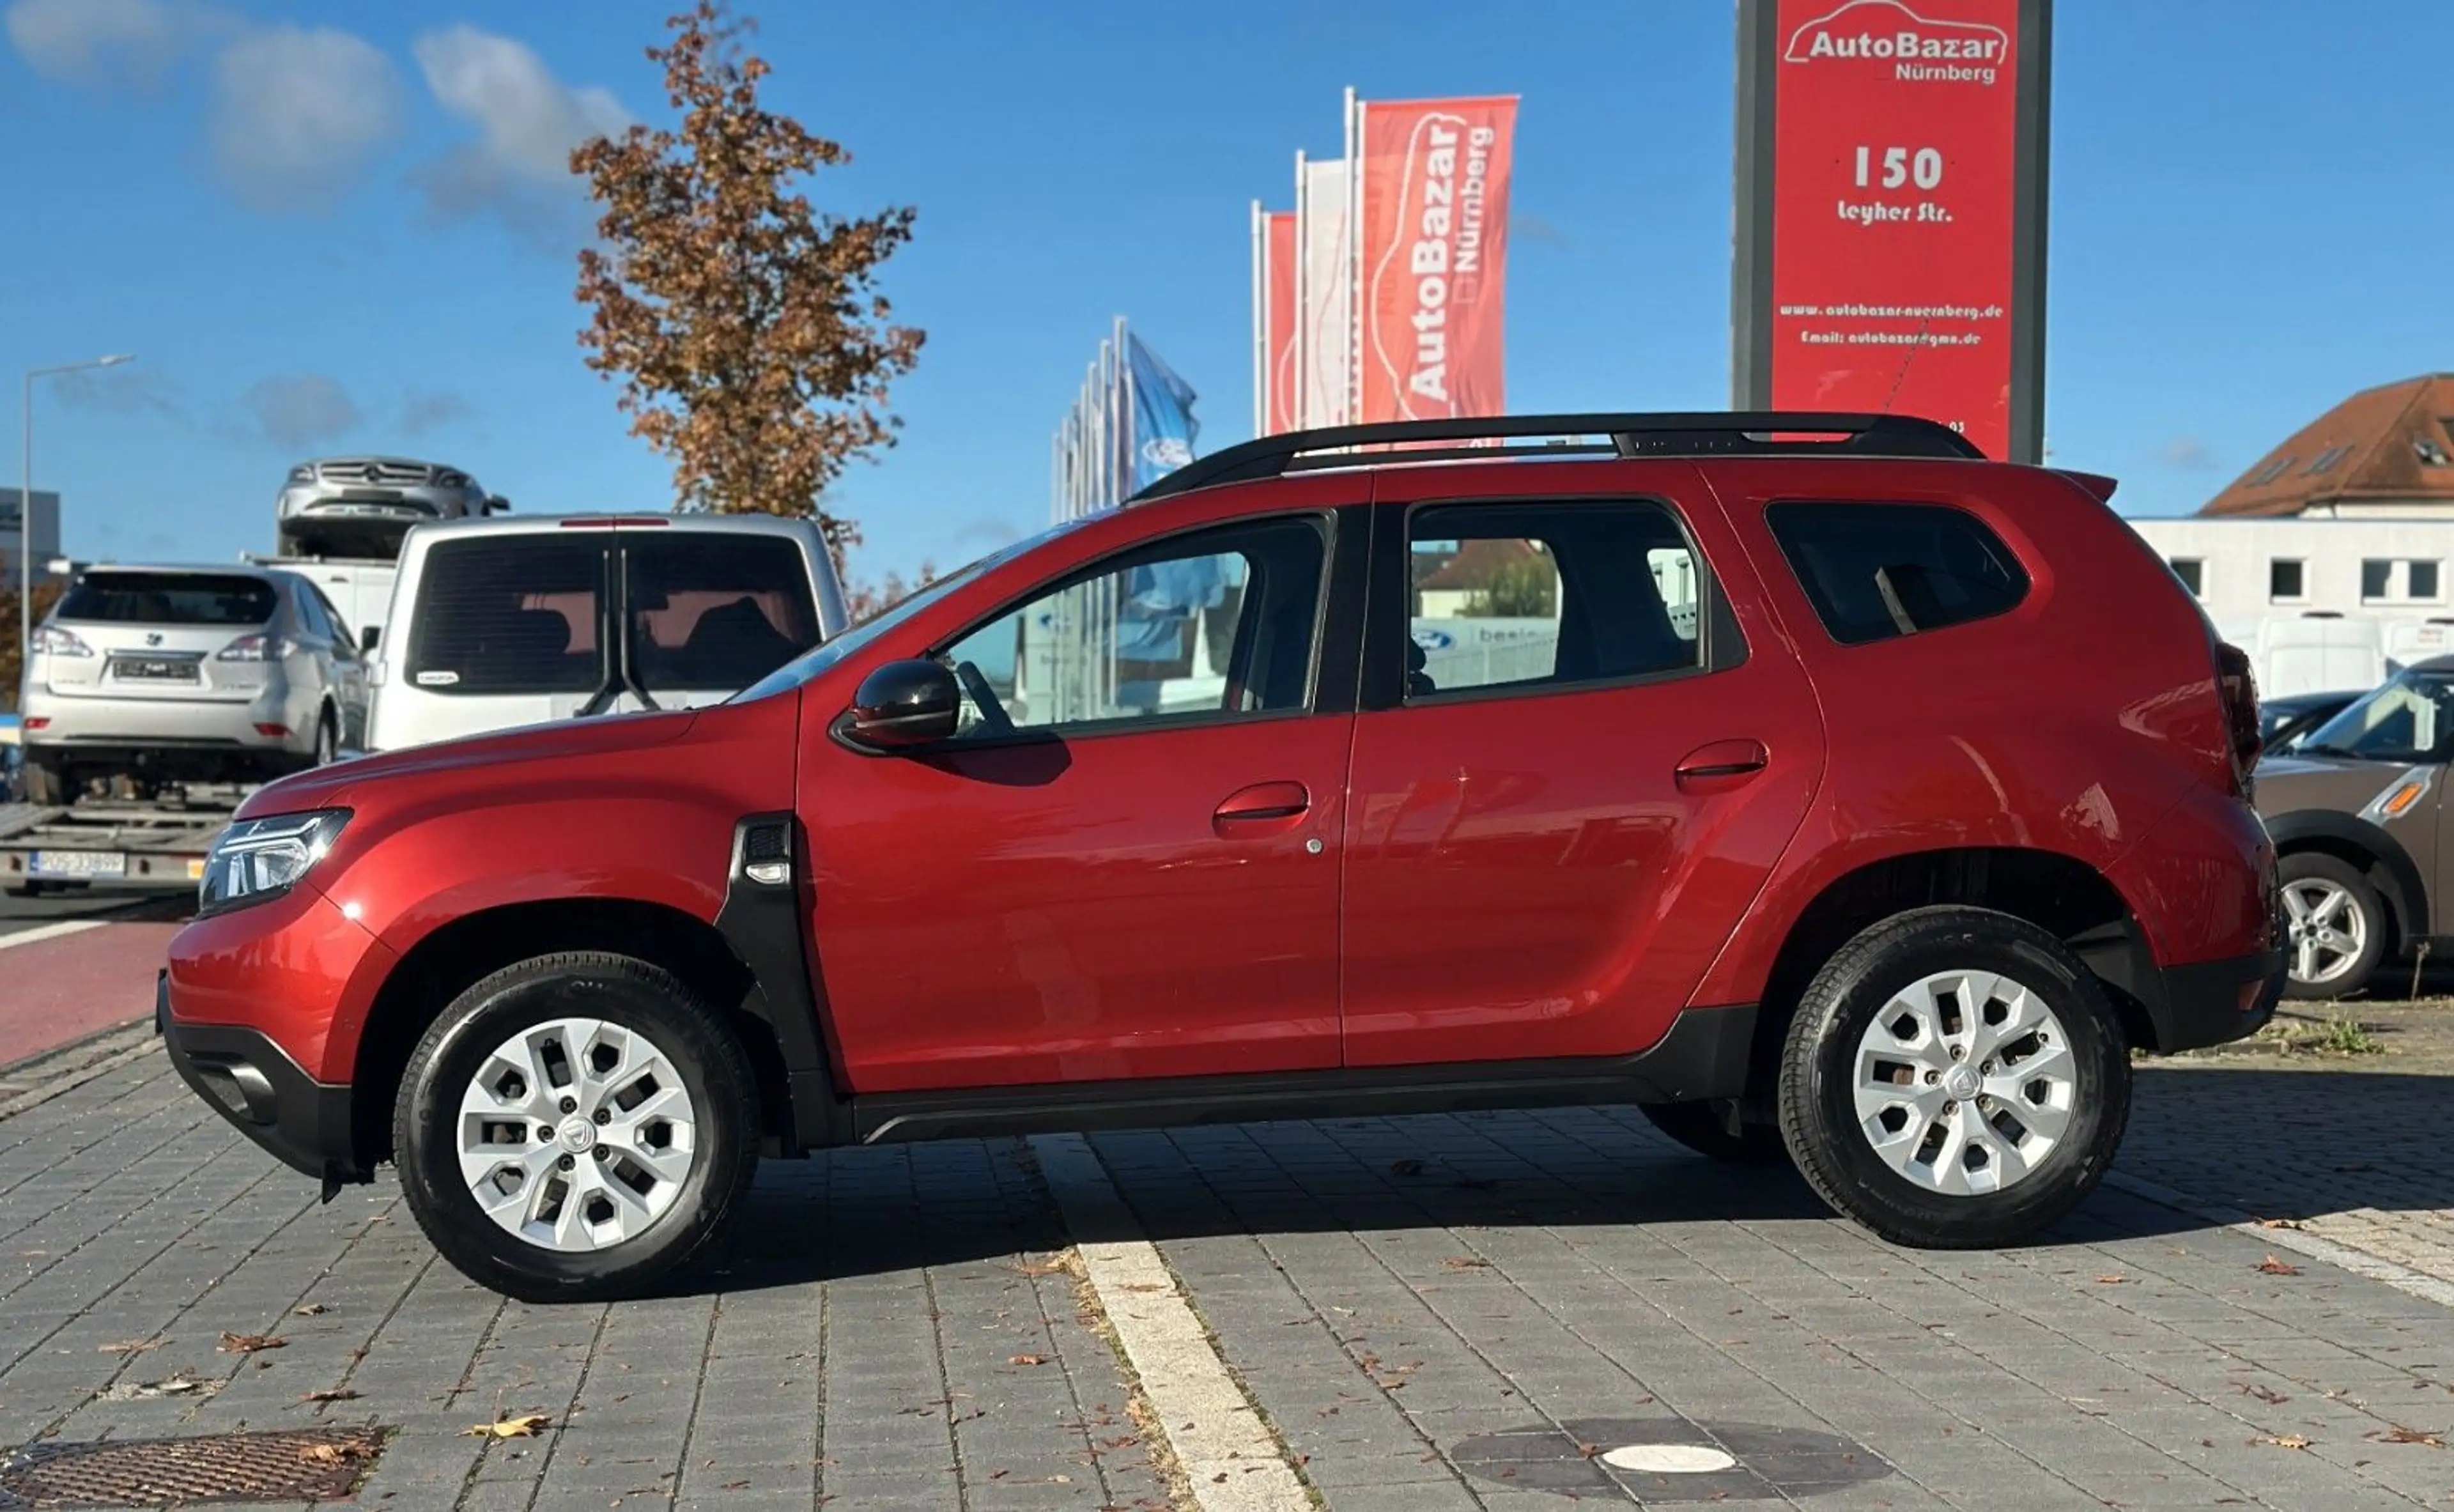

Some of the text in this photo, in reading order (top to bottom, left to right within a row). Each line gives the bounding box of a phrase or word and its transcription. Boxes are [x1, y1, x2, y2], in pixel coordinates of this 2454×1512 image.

[1810, 31, 1998, 58] AutoBazar
[1895, 64, 1995, 84] Nürnberg
[1856, 146, 1941, 190] 150
[1838, 199, 1953, 226] Leyher Str.
[1410, 125, 1458, 402] AutoBazar
[1801, 330, 1844, 343] Email:
